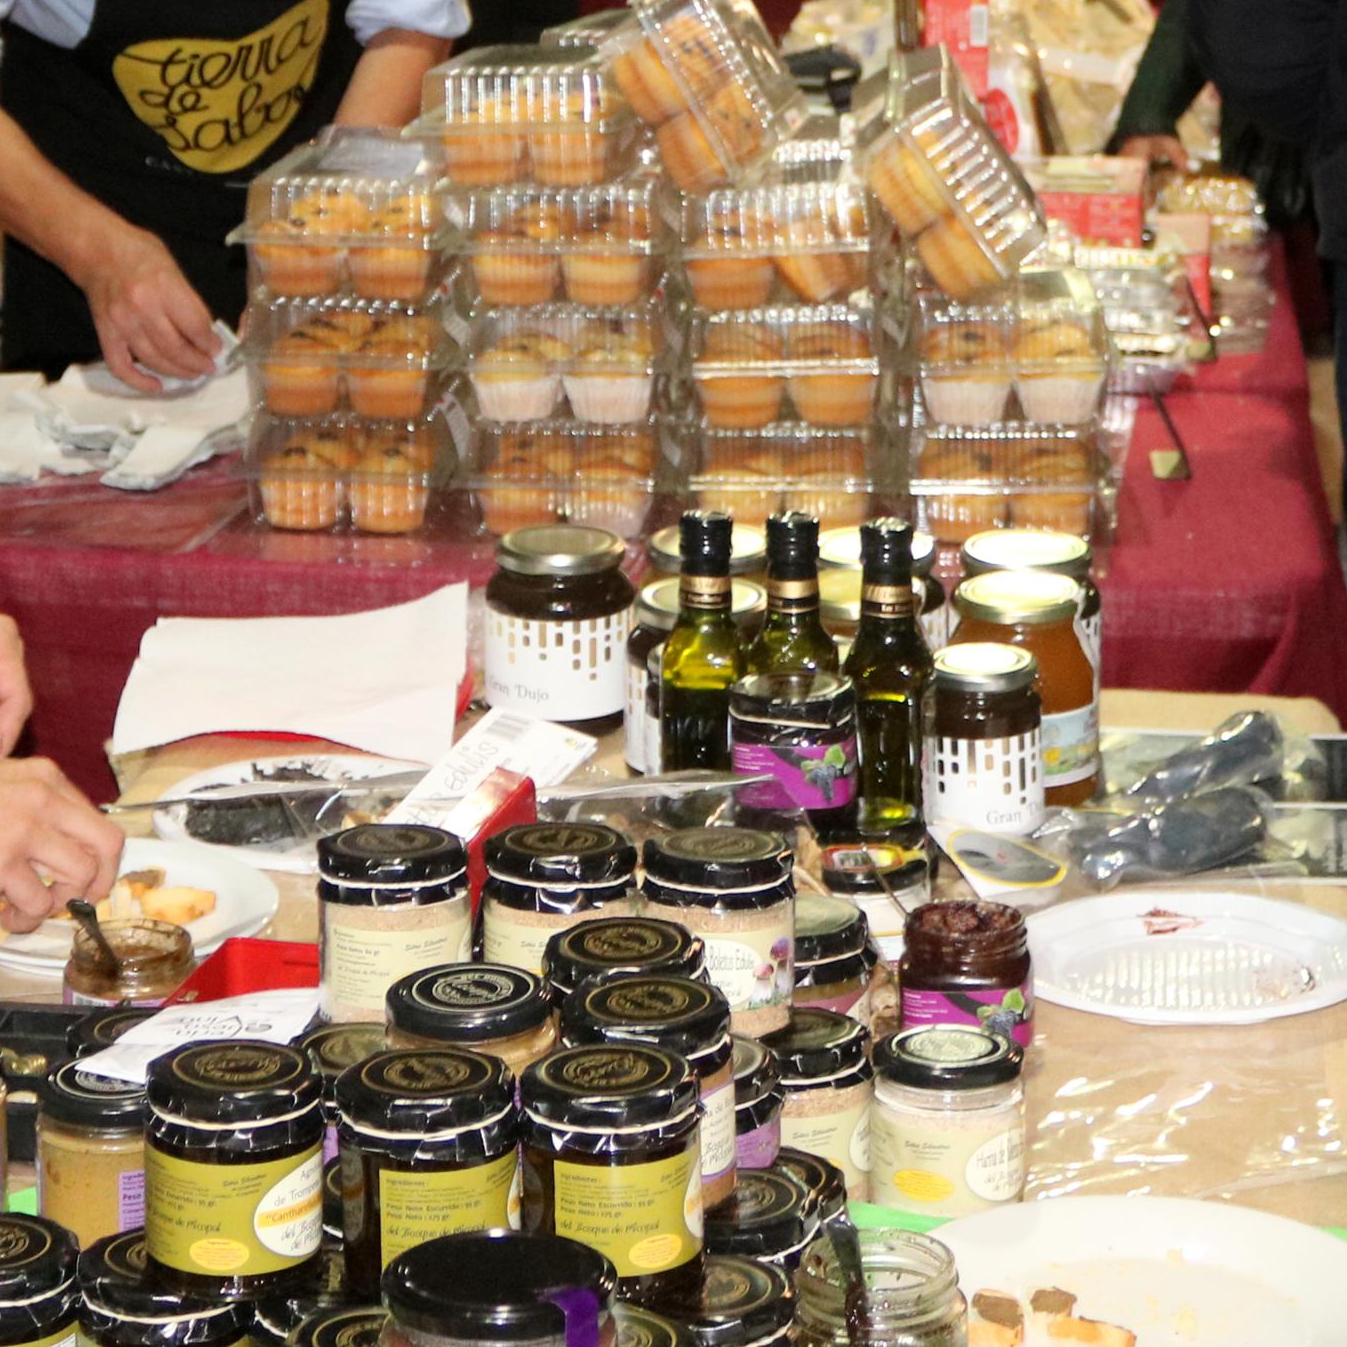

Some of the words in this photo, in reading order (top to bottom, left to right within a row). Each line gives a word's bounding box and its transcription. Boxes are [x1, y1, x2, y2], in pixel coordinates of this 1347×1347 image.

[152, 16, 317, 90] tierra
[139, 86, 210, 117] de
[515, 684, 549, 703] Dujo
[986, 810, 1022, 825] Gran
